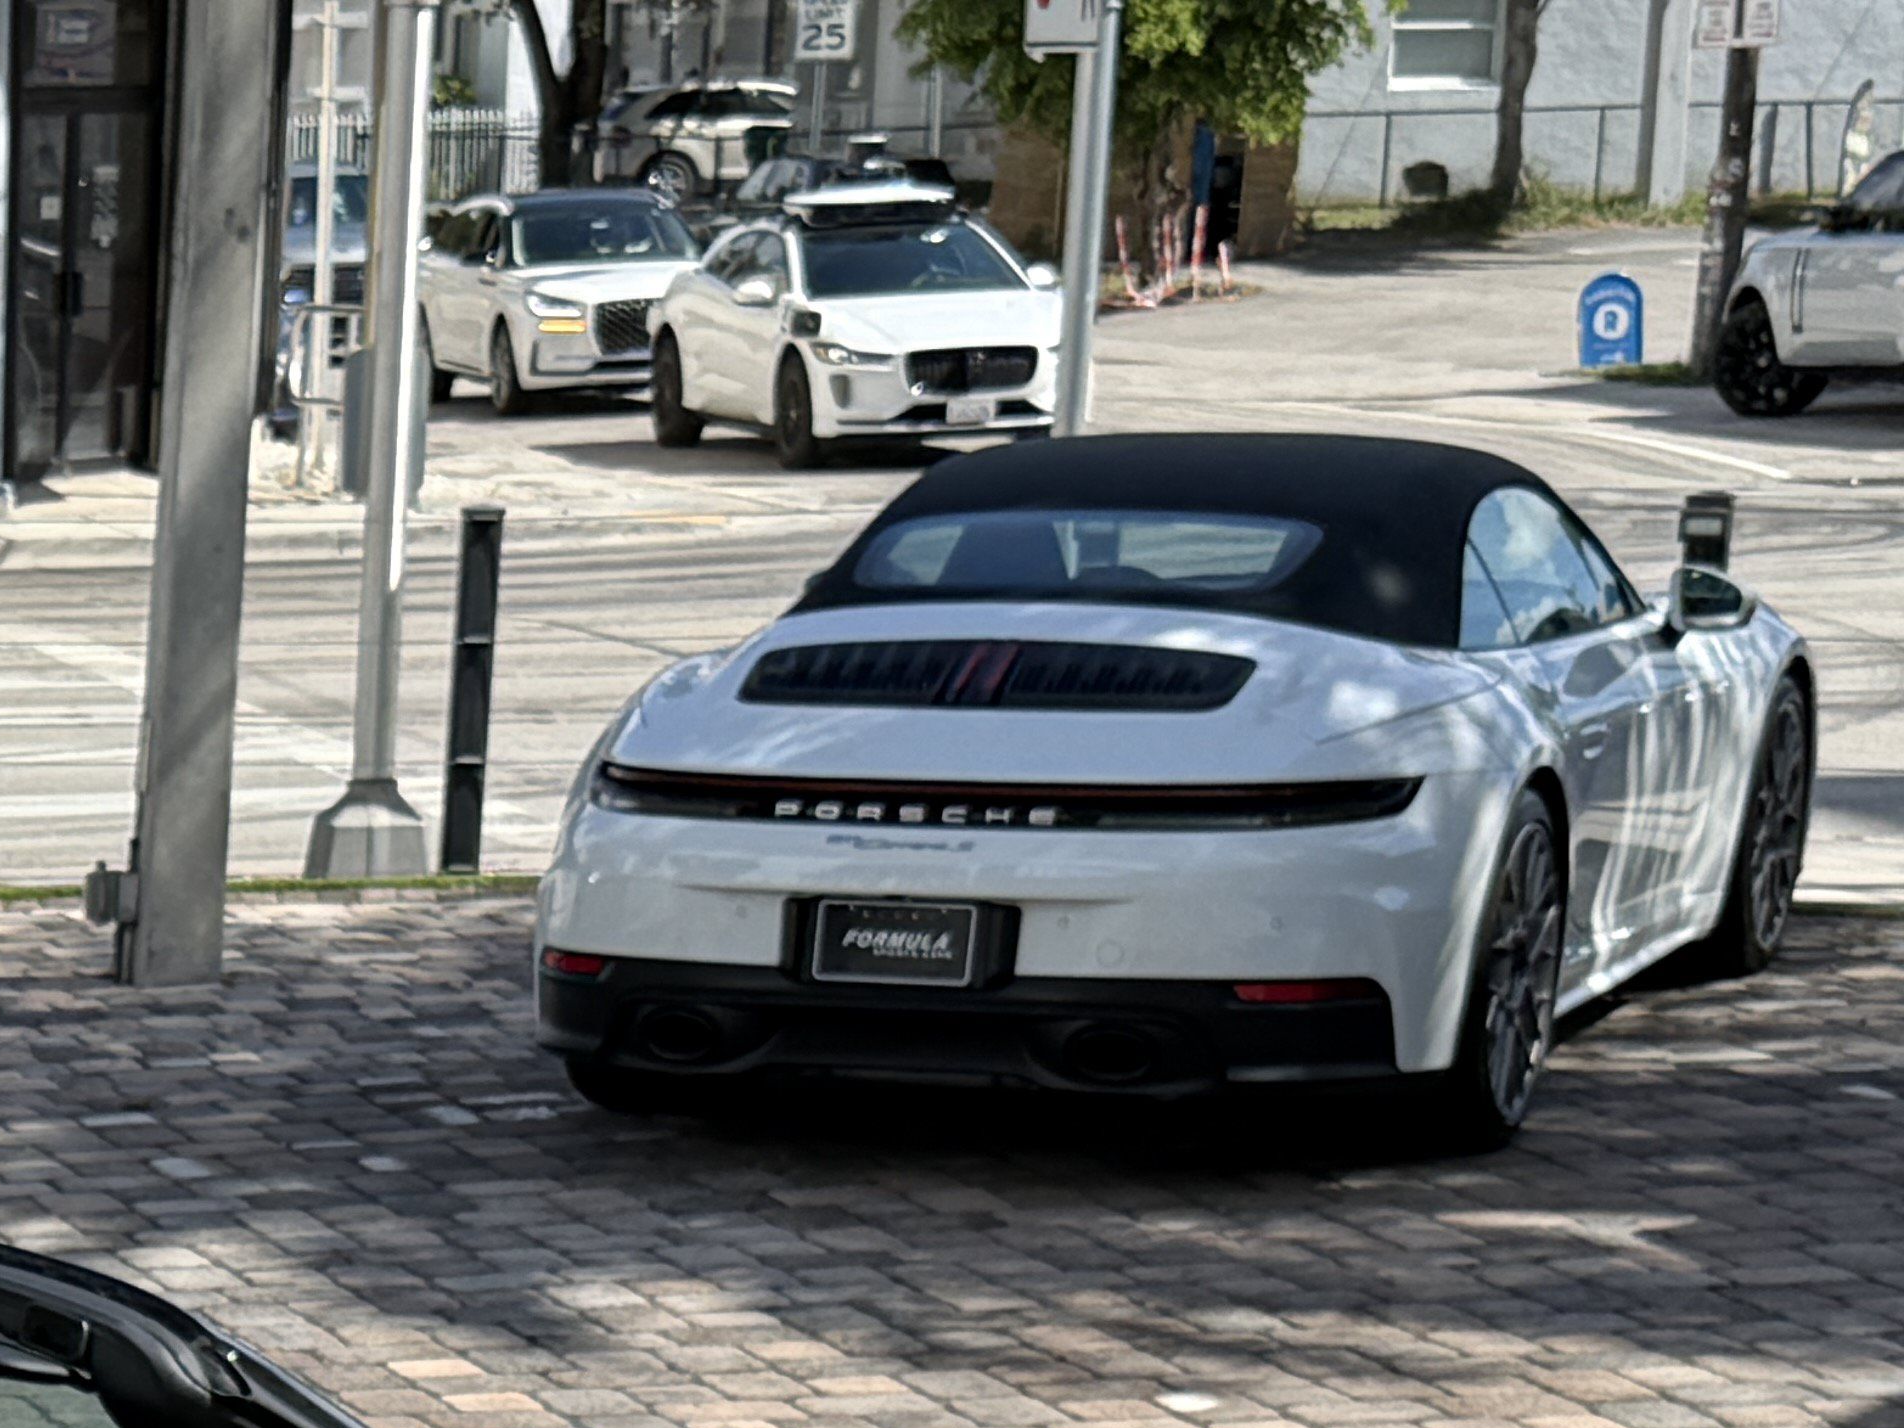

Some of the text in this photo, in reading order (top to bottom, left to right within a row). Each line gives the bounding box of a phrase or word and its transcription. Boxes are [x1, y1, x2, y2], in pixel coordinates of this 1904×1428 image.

[803, 24, 846, 51] 25
[774, 800, 1059, 825] PORSCHE
[842, 927, 951, 952] FORMULA
